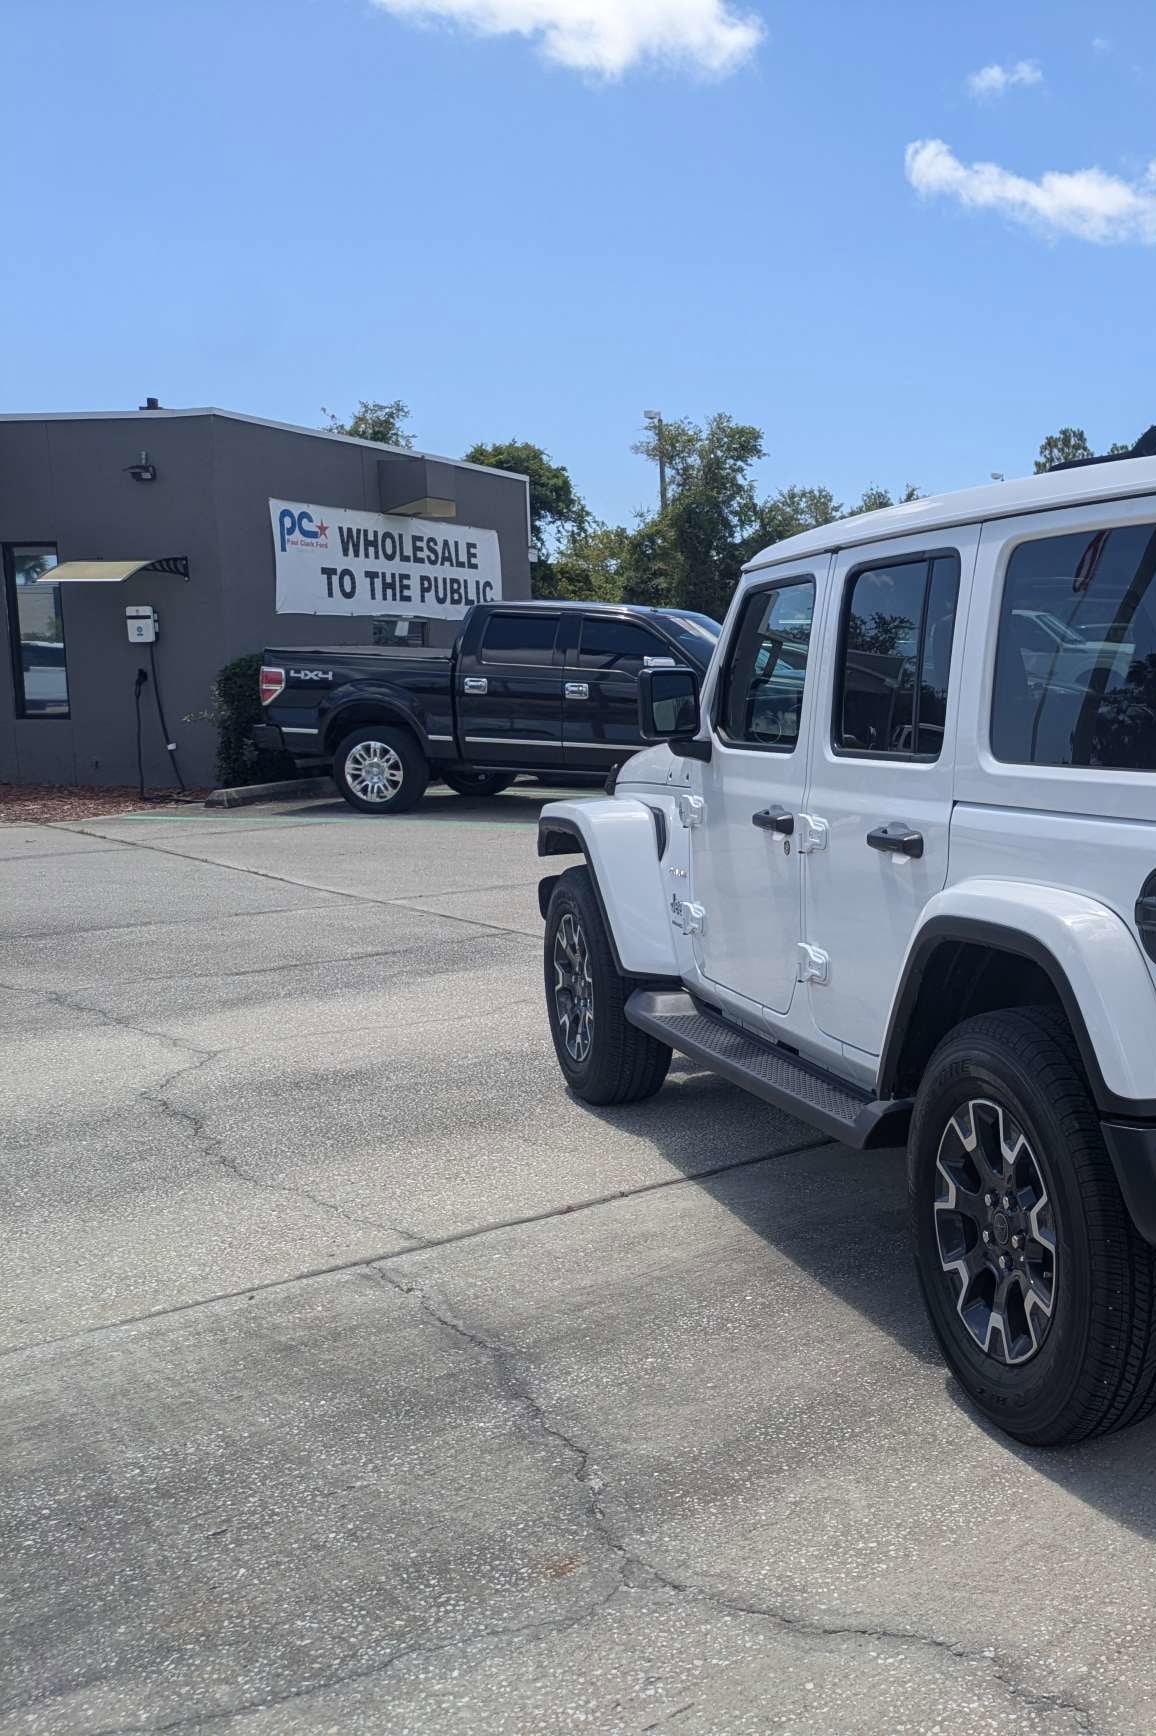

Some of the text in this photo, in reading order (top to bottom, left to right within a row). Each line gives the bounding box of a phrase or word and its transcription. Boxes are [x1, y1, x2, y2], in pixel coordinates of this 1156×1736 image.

[338, 526, 479, 570] WHOLESALE
[321, 567, 495, 606] TO THE PUBLIC
